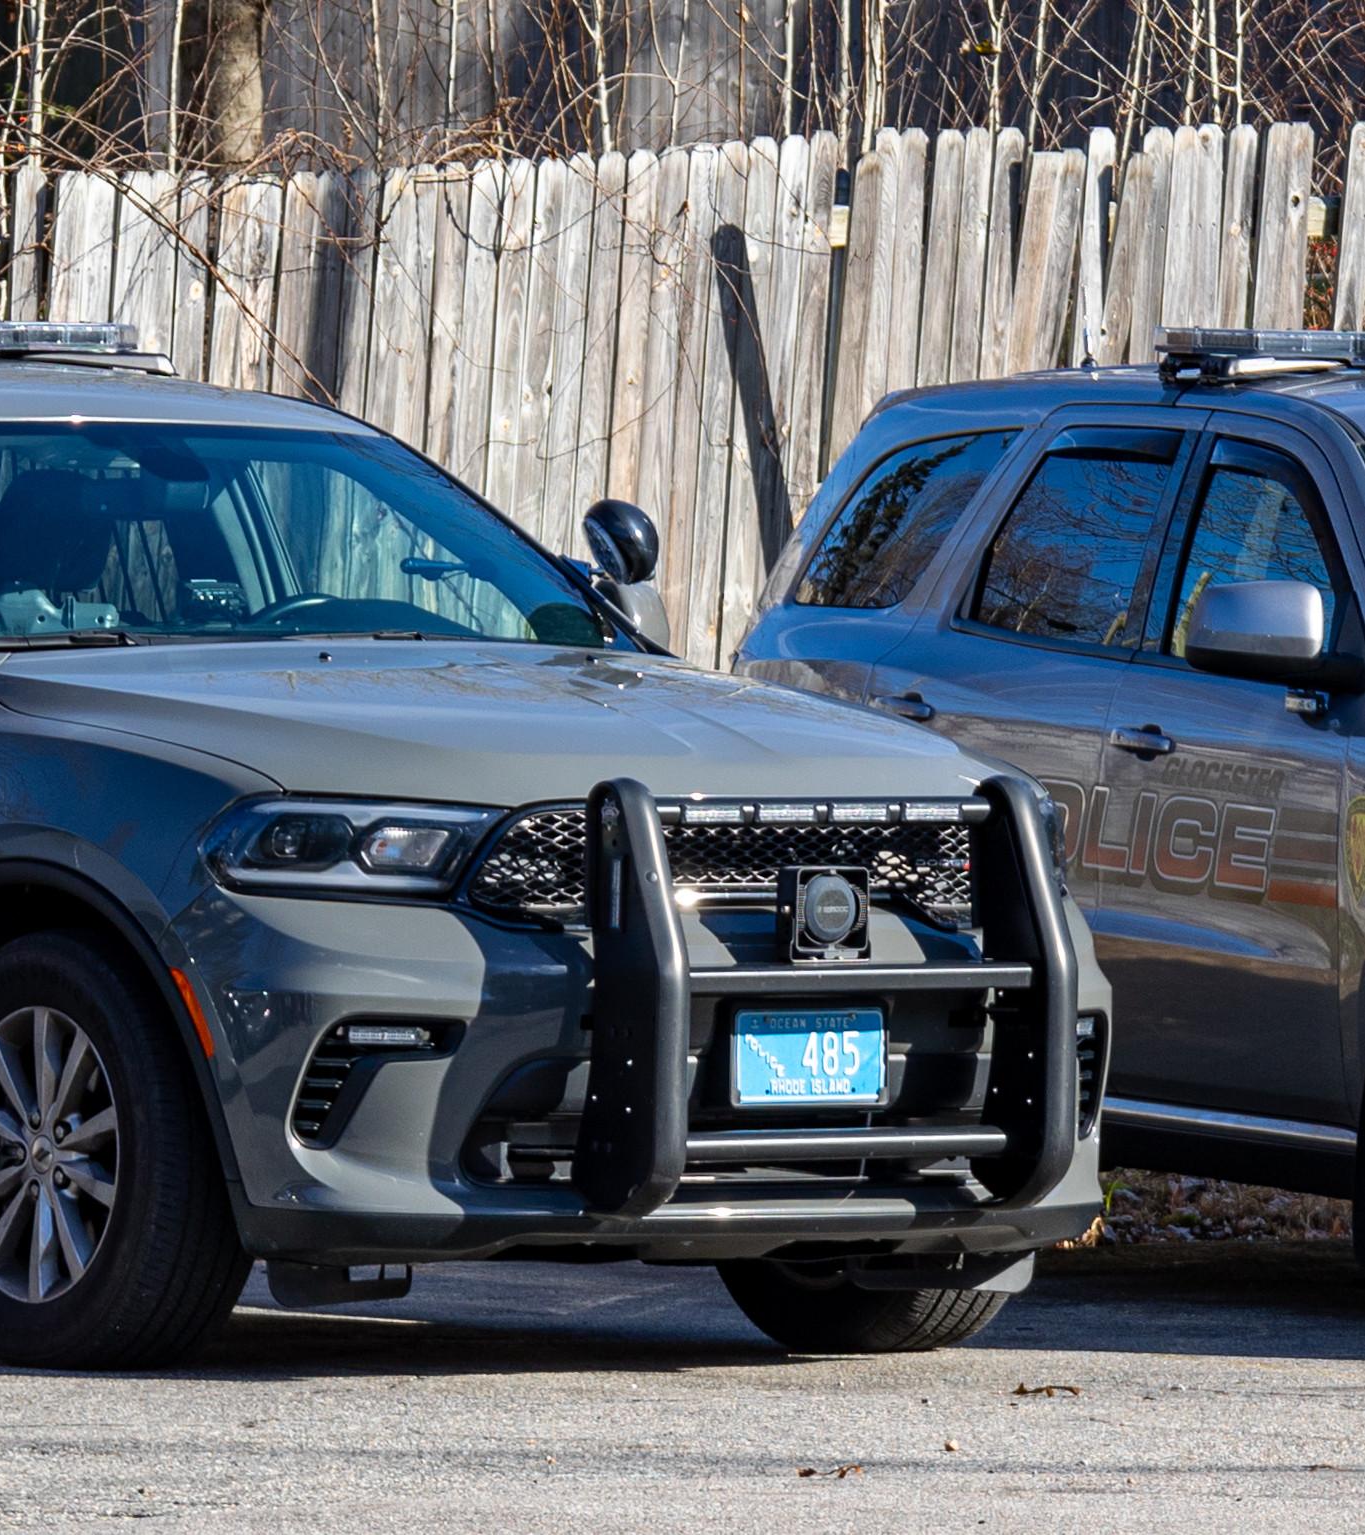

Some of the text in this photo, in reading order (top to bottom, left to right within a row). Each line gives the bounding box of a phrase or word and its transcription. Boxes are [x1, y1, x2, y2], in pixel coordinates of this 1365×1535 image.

[1162, 757, 1285, 798] GLOCESTER
[1038, 779, 1276, 892] LICE
[770, 1017, 849, 1029] OCEAN STATE
[745, 1034, 785, 1077] POLICE
[802, 1031, 860, 1076] 485
[770, 1078, 851, 1095] RHODE ISLAND
